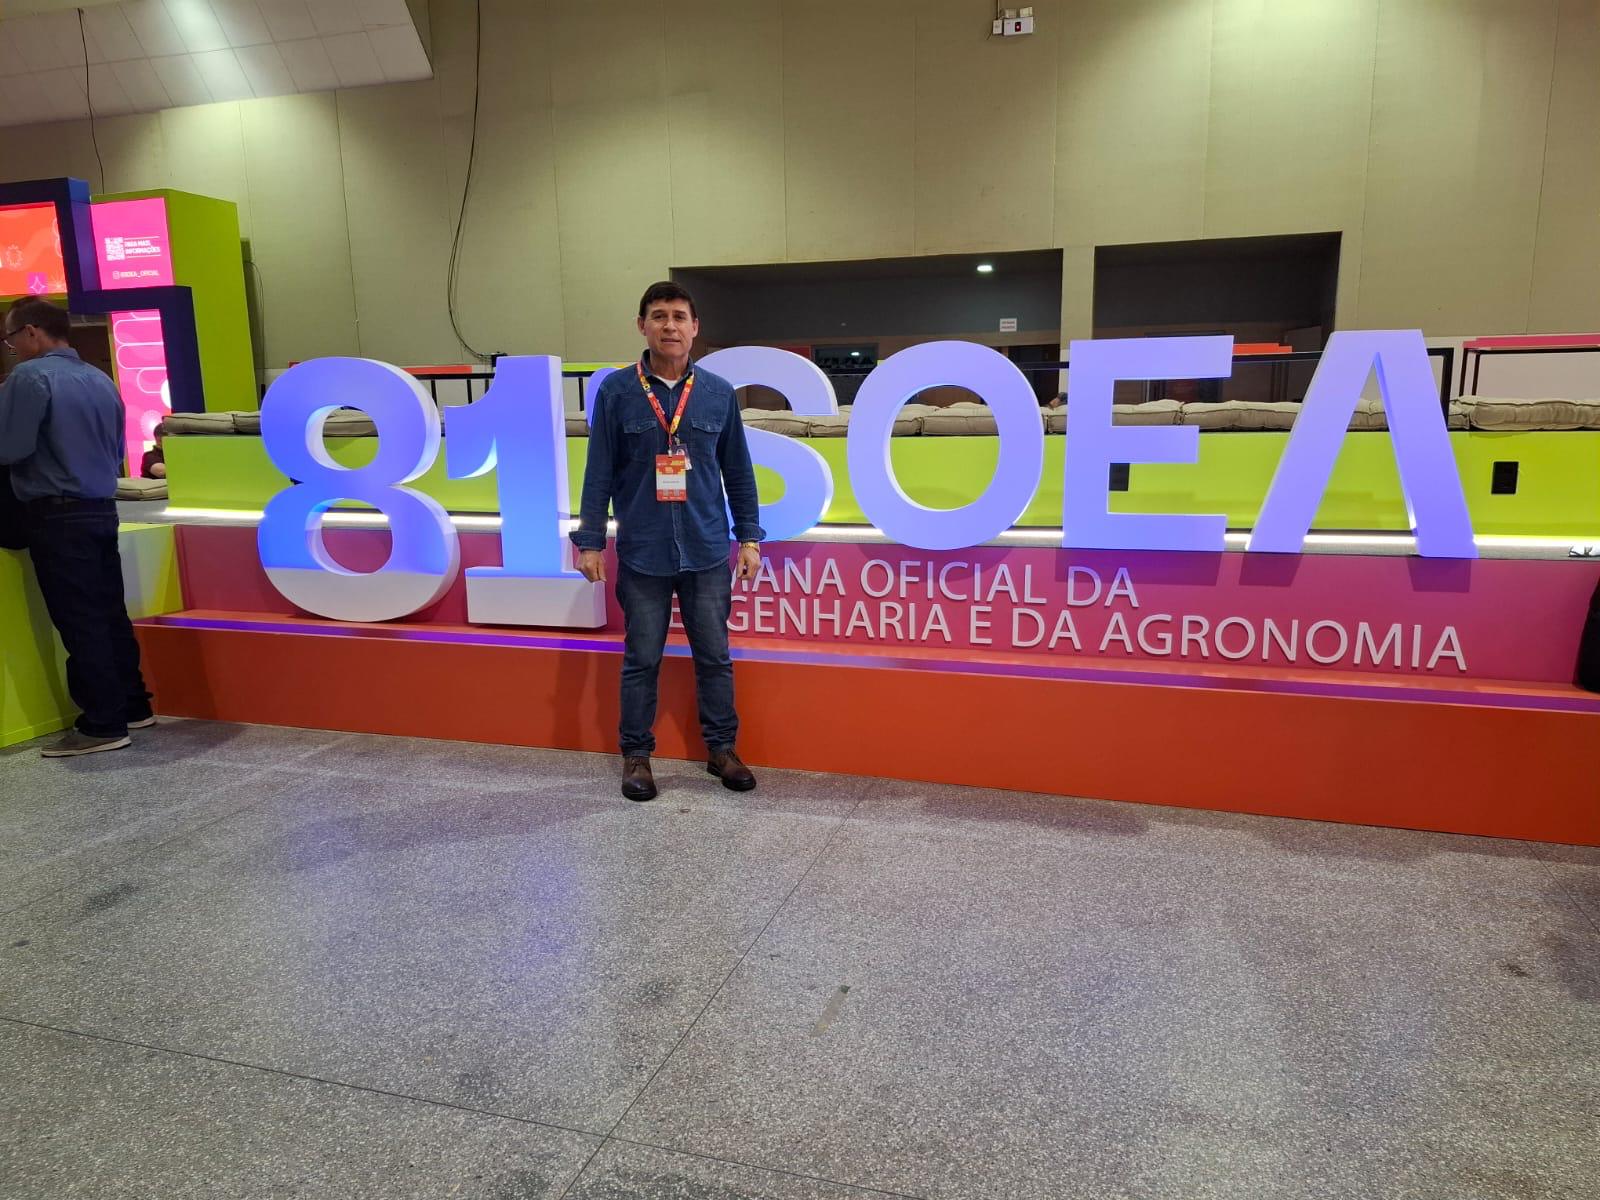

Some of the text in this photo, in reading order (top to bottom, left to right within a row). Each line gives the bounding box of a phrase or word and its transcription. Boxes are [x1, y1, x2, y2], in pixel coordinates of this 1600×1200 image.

[258, 329, 1479, 627] 81 SOEA
[730, 556, 1140, 608] ANA OFICIAL DA
[969, 605, 993, 645] E
[1012, 607, 1082, 651] DA
[1099, 611, 1468, 672] AGRONOMIA
